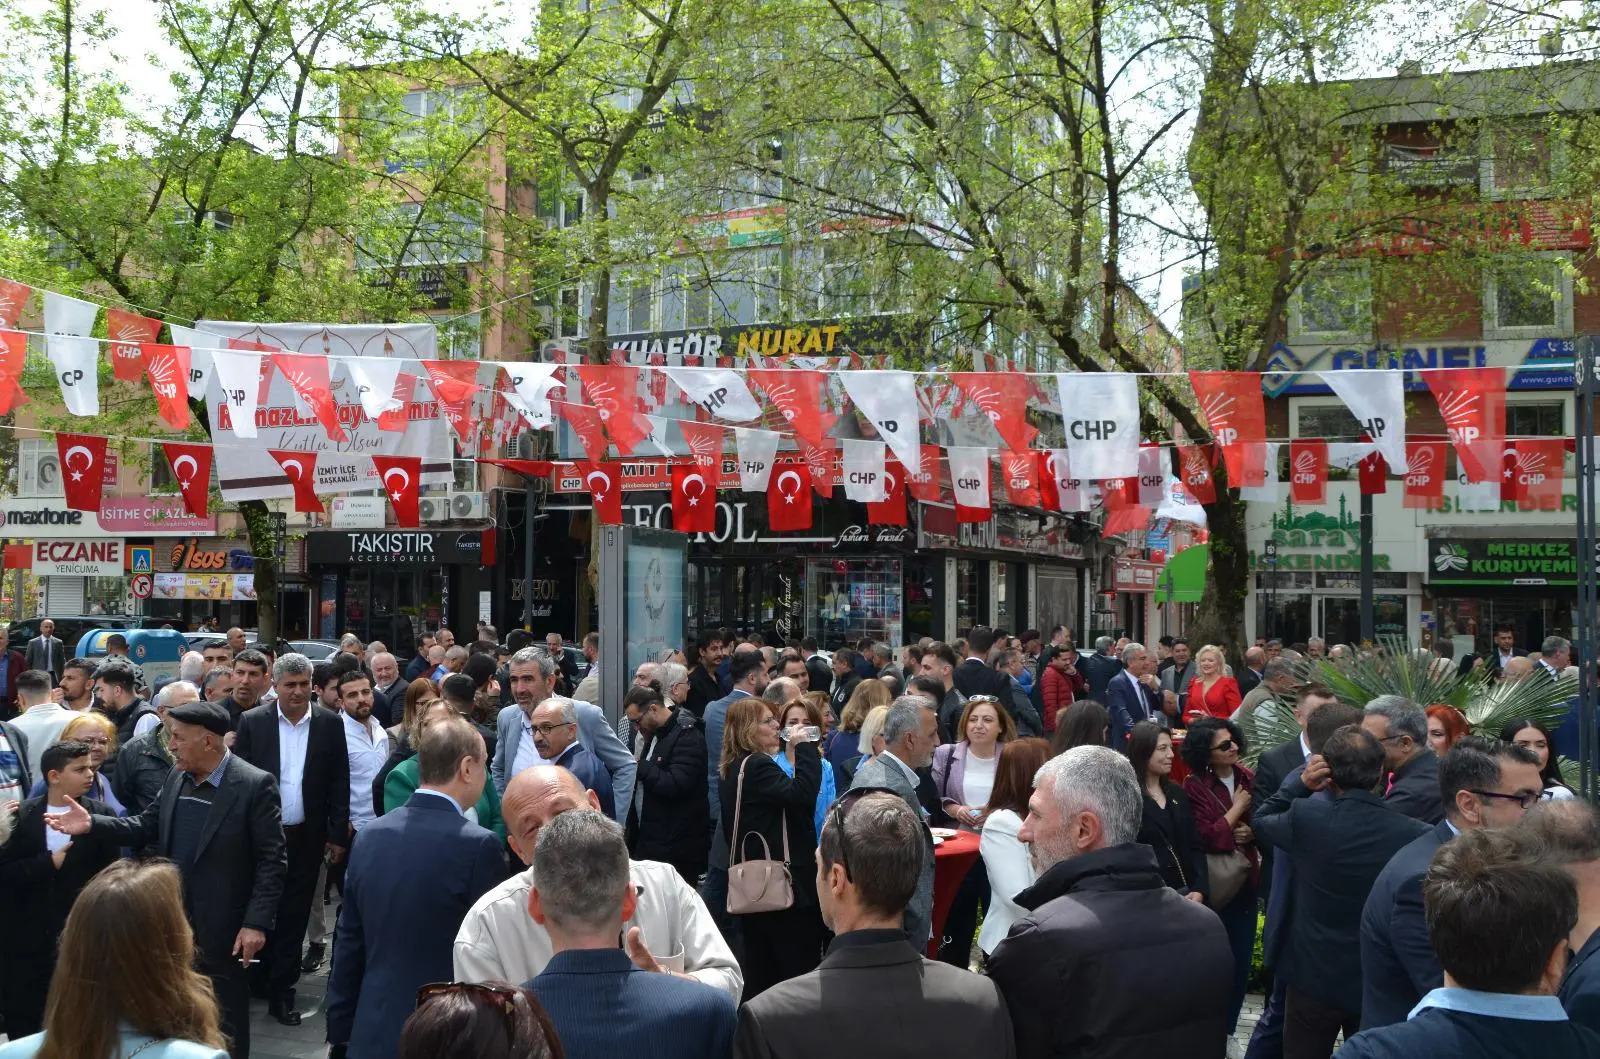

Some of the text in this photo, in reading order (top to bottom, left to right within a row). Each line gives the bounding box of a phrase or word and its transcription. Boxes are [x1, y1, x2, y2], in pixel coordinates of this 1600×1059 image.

[737, 325, 842, 357] MURAT
[116, 345, 141, 358] CHP
[154, 382, 177, 399] CHP
[223, 389, 245, 406] HP
[702, 386, 729, 415] HP
[1070, 420, 1117, 440] CHP
[1361, 417, 1385, 438] HP
[1216, 427, 1238, 447] HP
[317, 464, 338, 476] İZMİT
[340, 464, 356, 474] İLÇE
[743, 460, 765, 474] HP
[319, 474, 358, 486] BAŞKANLIĞI
[561, 480, 581, 488] CHP
[849, 472, 877, 484] CHP
[957, 478, 980, 490] CHP
[1010, 478, 1029, 490] CHP
[1060, 478, 1081, 490] CHP
[1104, 479, 1125, 490] CHP
[1141, 475, 1163, 487] CHP
[1187, 473, 1207, 486] CHP
[1293, 473, 1316, 485] CHP
[1405, 475, 1430, 486] CHP
[1518, 474, 1546, 485] CHP
[7, 506, 83, 525] maxtone
[101, 506, 140, 521] İŞİTME
[832, 525, 908, 548] fashion brands
[36, 541, 119, 562] ECZANE
[1487, 543, 1569, 557] MERKEZ
[55, 563, 100, 575] YENİCUMA
[1472, 555, 1580, 573] KURUYEMİ
